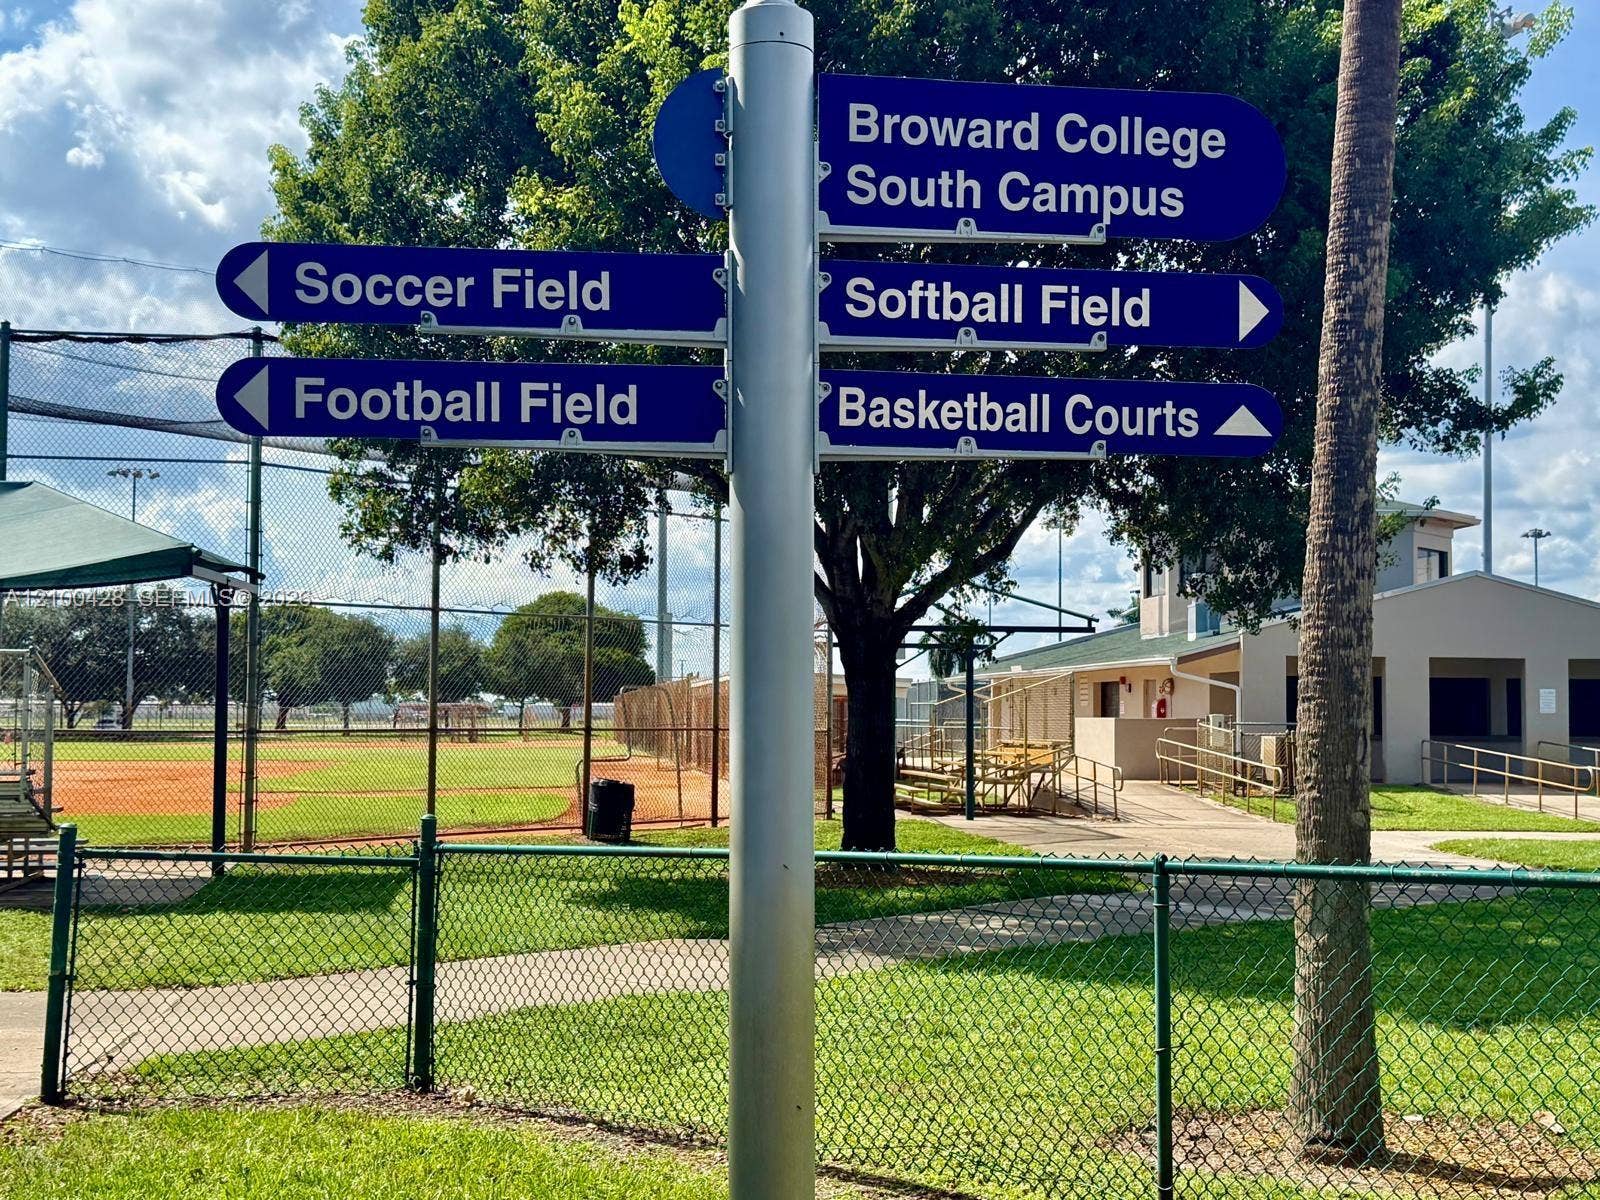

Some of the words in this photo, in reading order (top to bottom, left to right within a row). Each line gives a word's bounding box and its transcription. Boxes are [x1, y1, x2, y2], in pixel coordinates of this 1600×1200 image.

[848, 103, 1040, 151] Broward
[1056, 113, 1226, 168] College
[846, 164, 982, 209] South
[998, 171, 1185, 225] Campus
[295, 262, 475, 307] Soccer
[492, 268, 611, 311] Field
[845, 277, 1023, 324] Softball
[1041, 285, 1150, 328] Field
[294, 377, 500, 422] Football
[520, 382, 638, 425] Field
[838, 387, 1050, 433] Basketball
[1064, 393, 1200, 437] Courts
